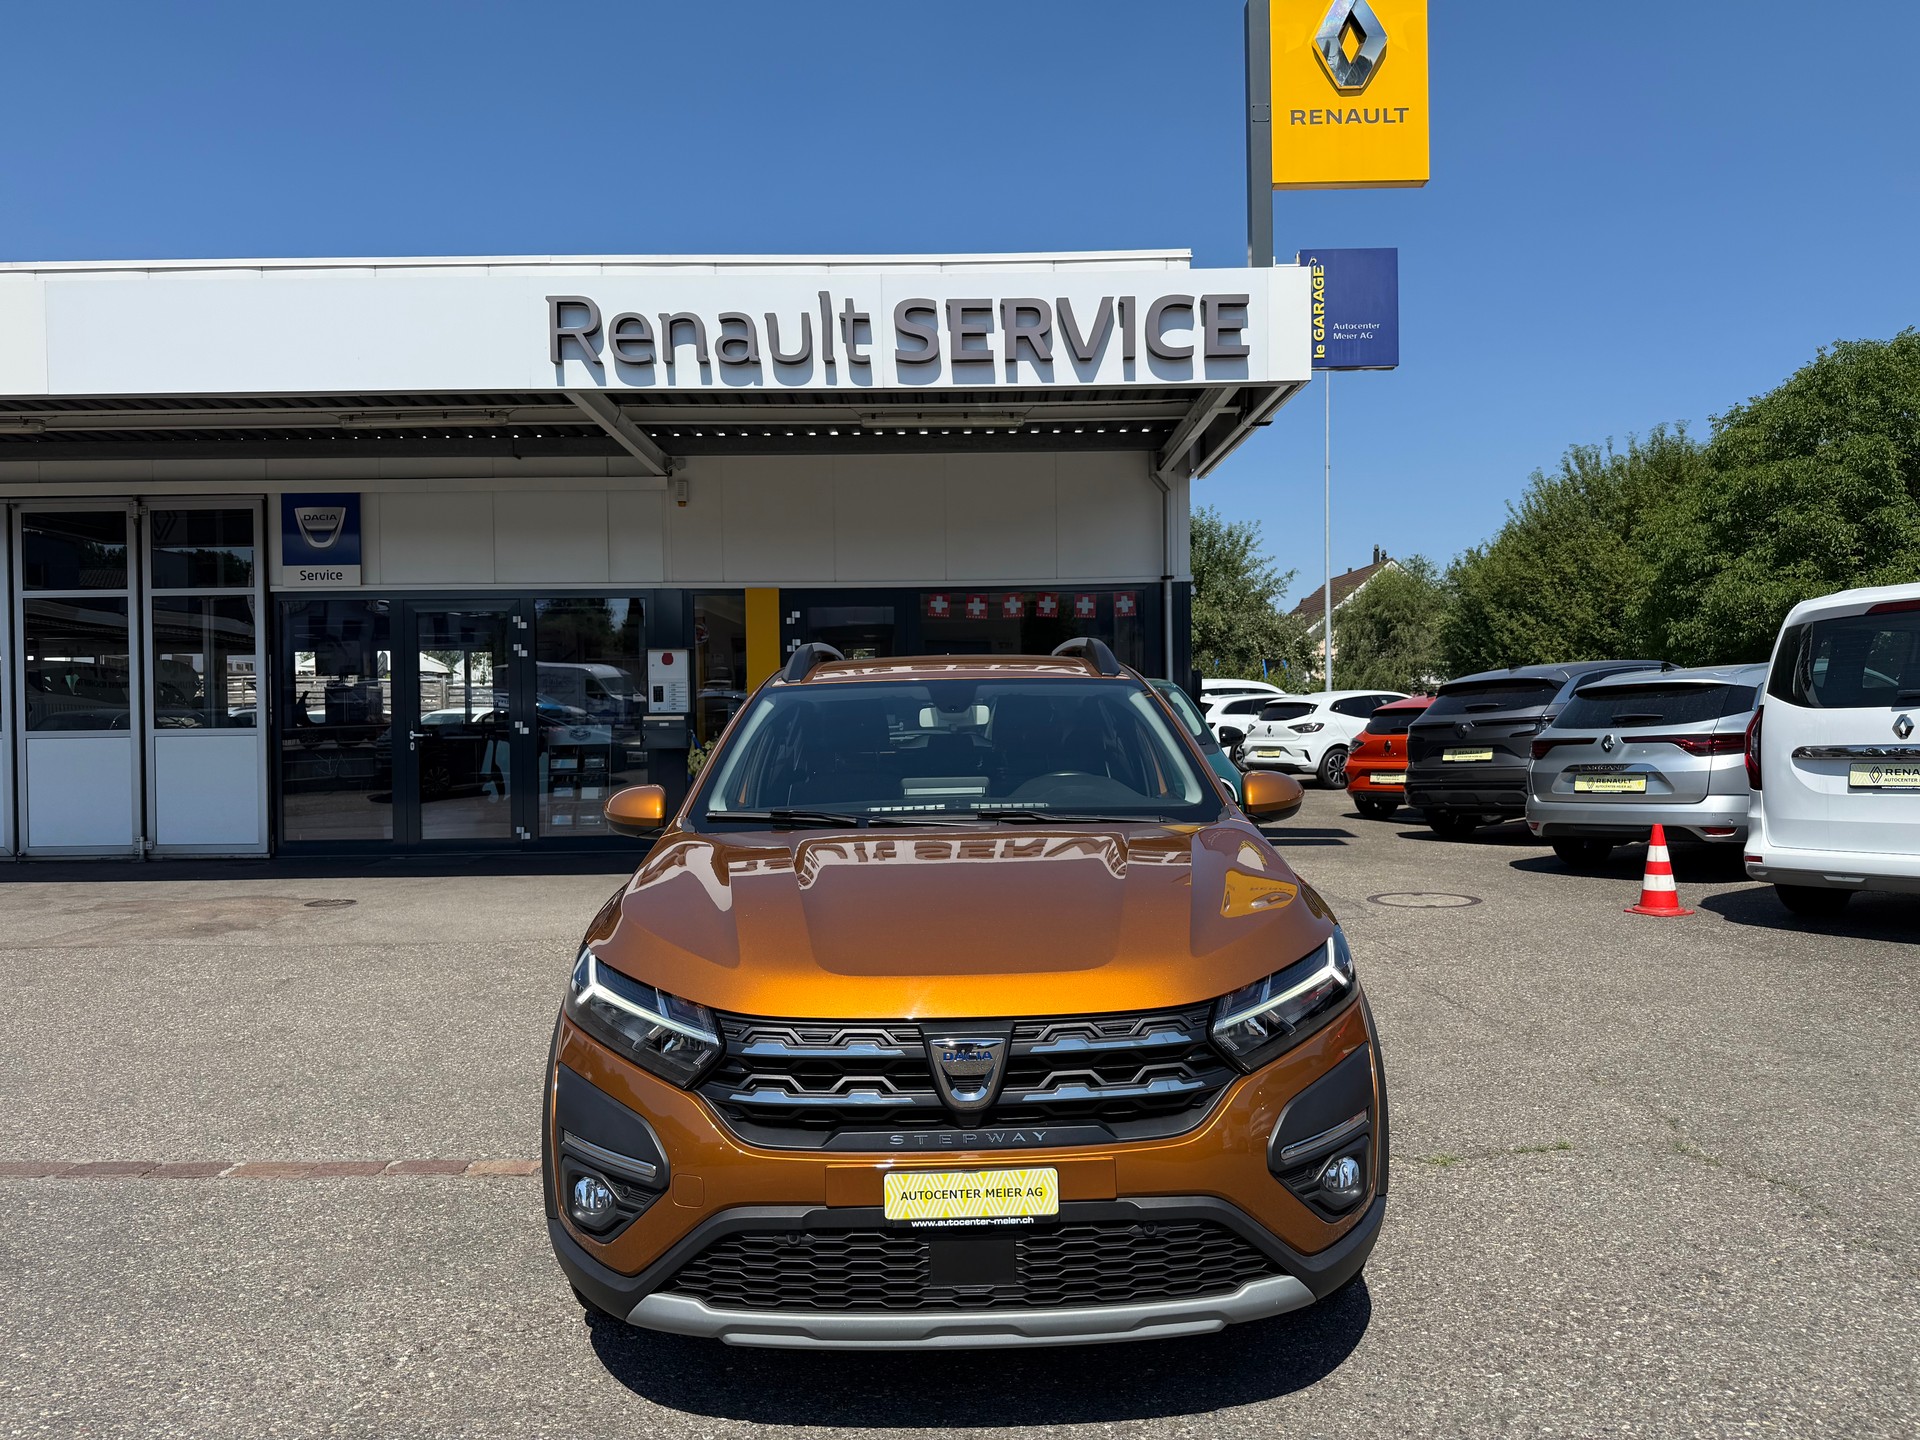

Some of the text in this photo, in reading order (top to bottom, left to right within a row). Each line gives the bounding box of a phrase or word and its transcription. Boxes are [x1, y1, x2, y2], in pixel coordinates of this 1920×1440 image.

[1290, 107, 1410, 126] RENAULT
[1312, 264, 1326, 359] le GARAGE
[545, 290, 1250, 365] Renault SERVICE
[1332, 322, 1381, 331] Autocenter
[1332, 331, 1374, 340] Meier AG
[299, 569, 344, 581] Service
[942, 1050, 994, 1062] DACIA
[889, 1131, 1047, 1145] STEPWAY
[900, 1186, 1043, 1201] AUTOCENTER MEIER AG
[911, 1215, 1034, 1228] www.autocenter-meier.ch
